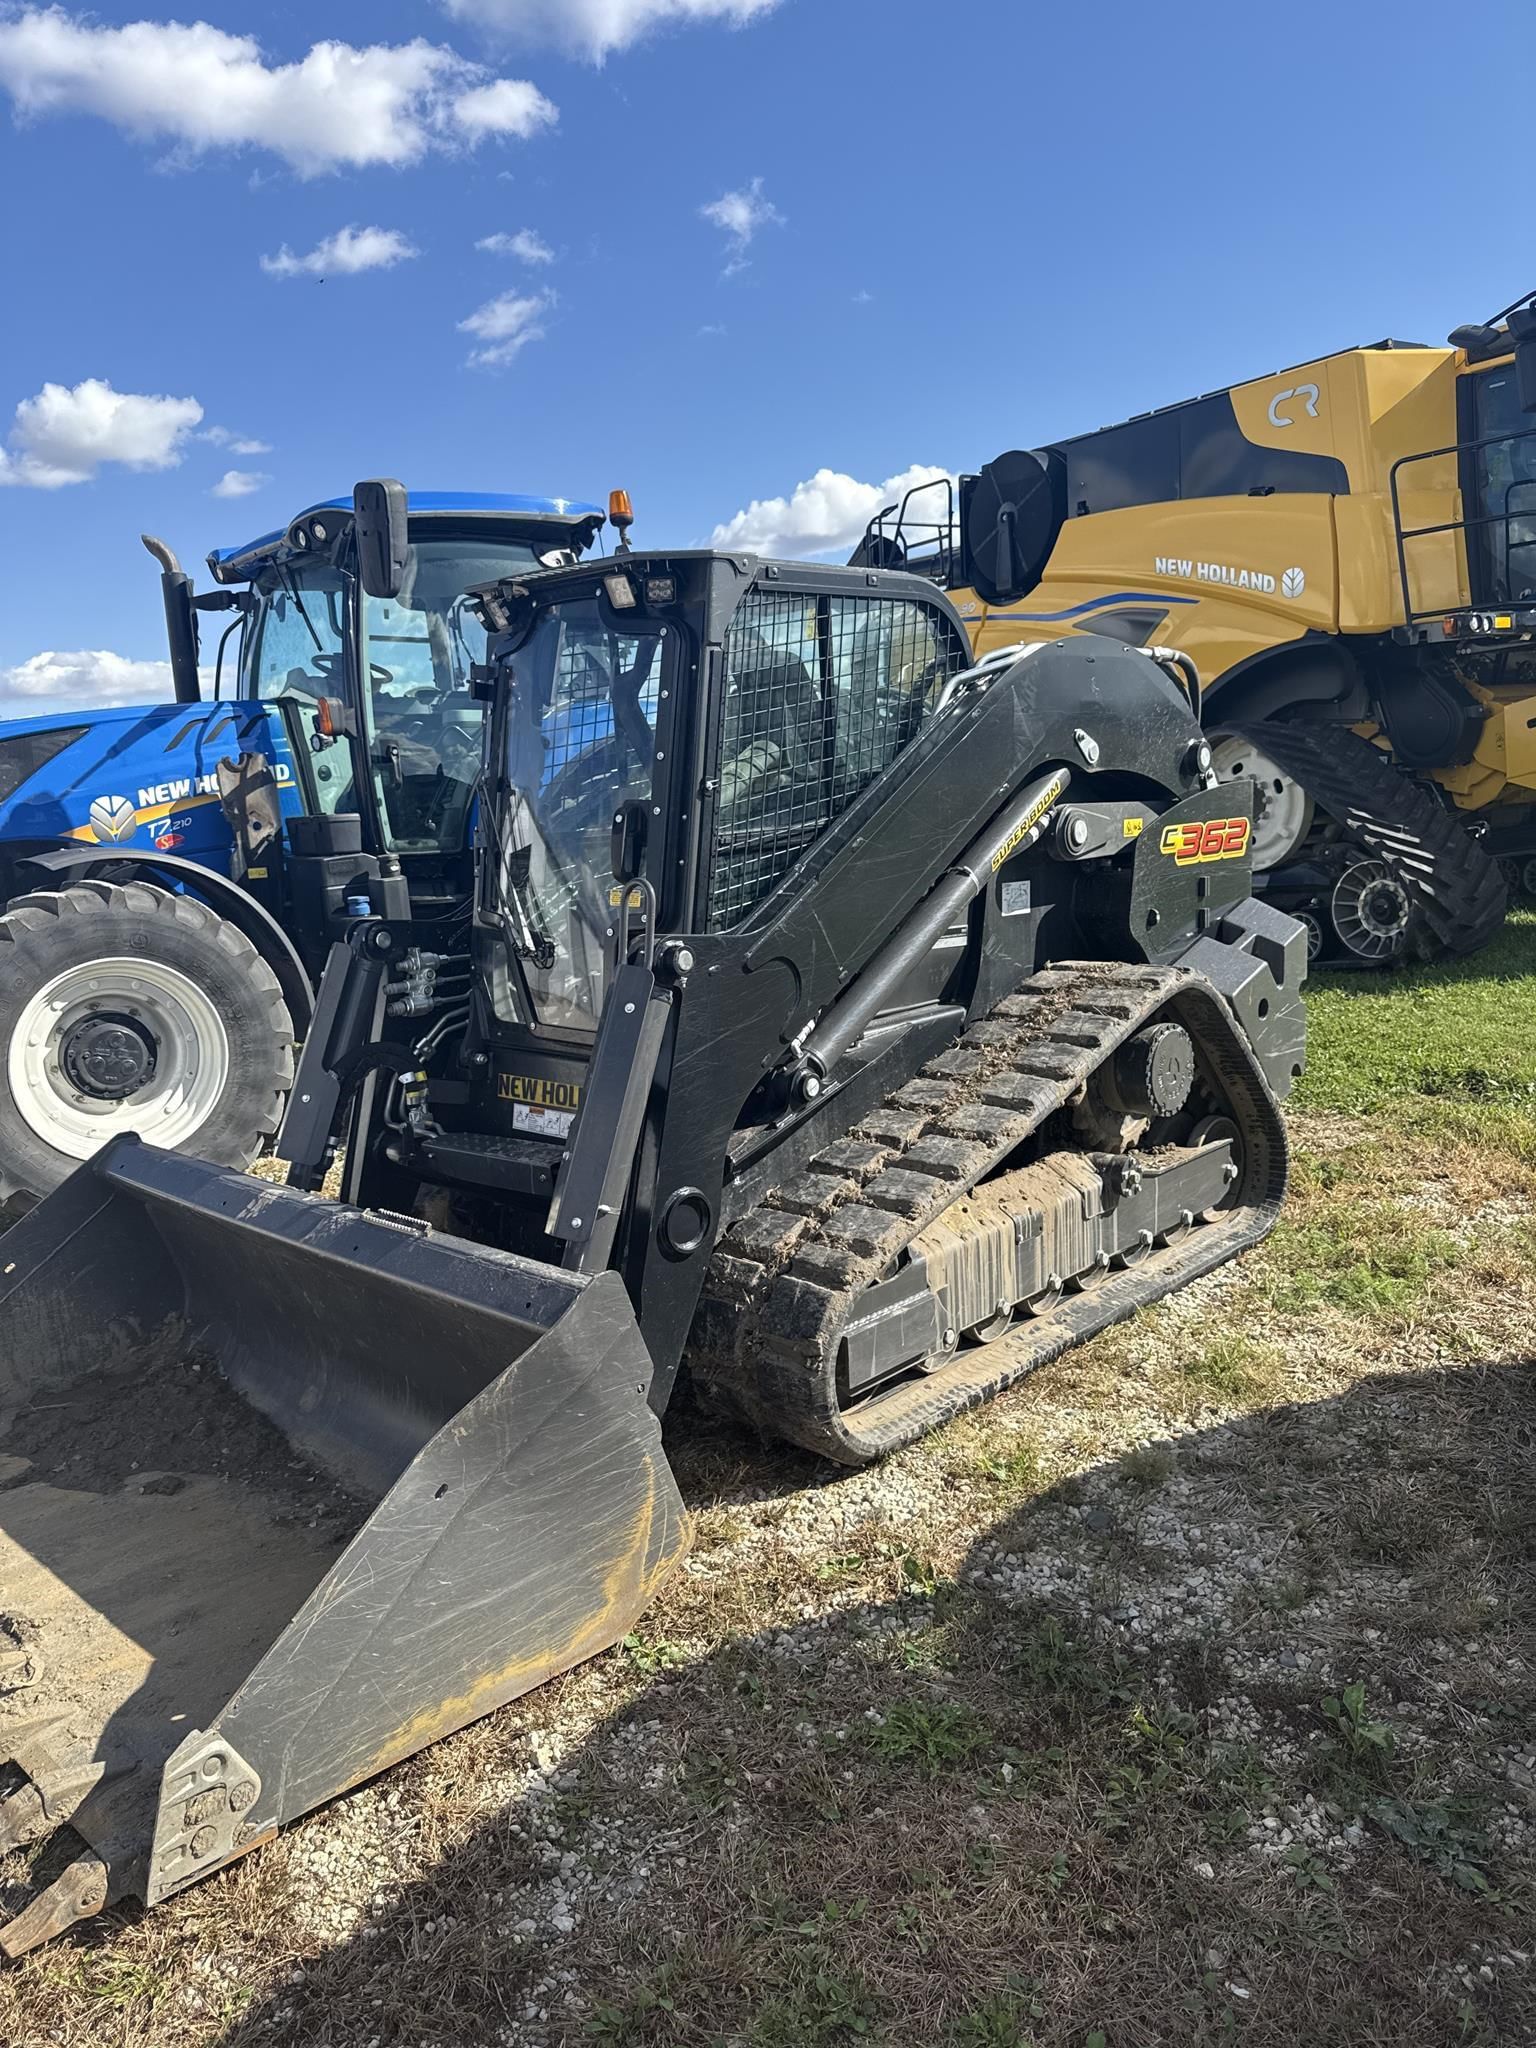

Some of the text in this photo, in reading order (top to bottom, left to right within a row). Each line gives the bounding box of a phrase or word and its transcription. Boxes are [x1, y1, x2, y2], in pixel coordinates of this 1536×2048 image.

[1268, 383, 1320, 428] CR
[1155, 557, 1276, 593] NEW HOLLAND
[138, 778, 190, 807] NEW
[1161, 817, 1250, 865] C362
[499, 1074, 578, 1108] NEW HOL
